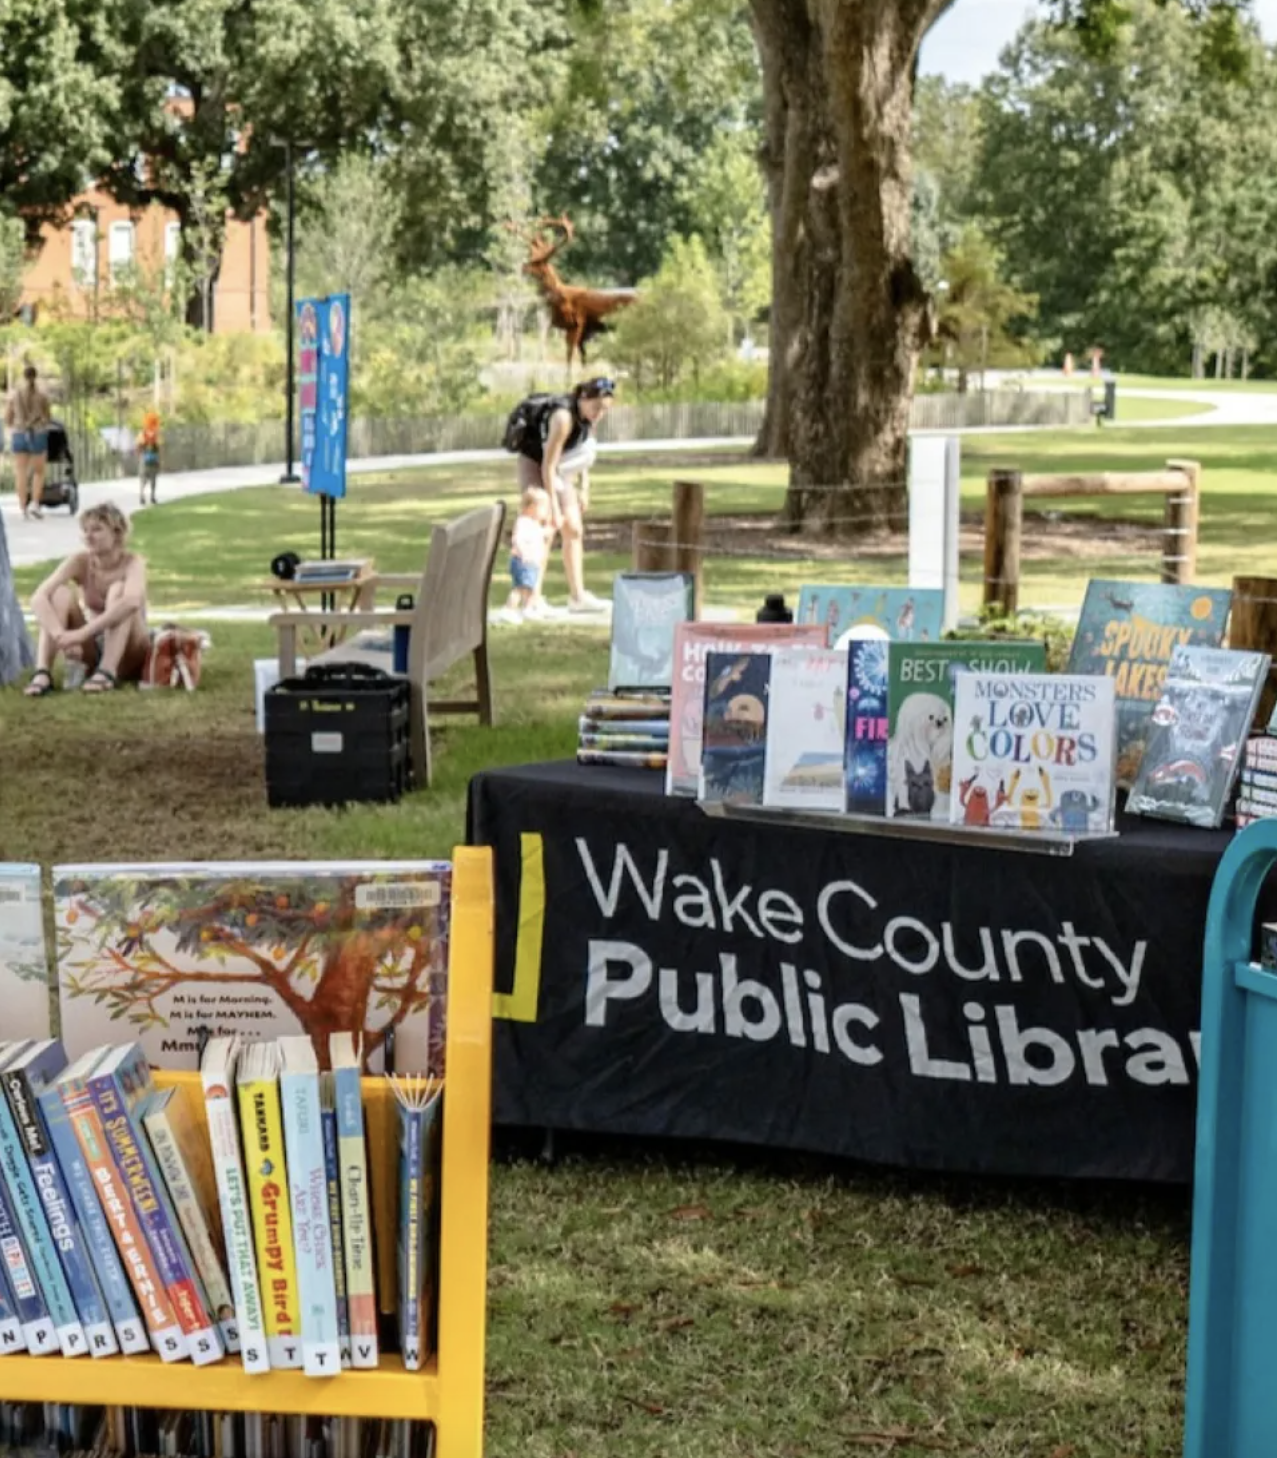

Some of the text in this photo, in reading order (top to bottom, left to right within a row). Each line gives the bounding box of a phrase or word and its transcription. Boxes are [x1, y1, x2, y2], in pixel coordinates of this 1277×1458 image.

[1100, 613, 1194, 659] SPOOKY
[900, 659, 1031, 682] BEST SHOW
[974, 680, 1096, 700] MONSTERS
[988, 700, 1080, 729] LOVE
[966, 730, 1097, 765] COLORS
[576, 837, 1147, 1006] Wake County
[173, 996, 184, 1004] M
[198, 995, 214, 1003] for
[217, 995, 269, 1006] Morning.
[586, 940, 882, 1065] Public
[170, 1010, 181, 1018] M
[195, 1009, 211, 1018] for
[98, 1088, 120, 1114] IT'S
[225, 1166, 242, 1205] LET'S
[33, 1161, 76, 1253] Feelings
[231, 1208, 245, 1237] PUT
[235, 1241, 252, 1277] THAT
[260, 1181, 288, 1327] Grumpy Bird
[2, 1330, 16, 1344] N
[36, 1330, 46, 1344] P
[124, 1328, 135, 1341] S
[227, 1327, 238, 1340] S
[69, 1334, 79, 1348] P
[94, 1335, 106, 1349] R
[165, 1337, 177, 1351] S
[198, 1339, 210, 1352] S
[247, 1349, 259, 1362] S
[285, 1348, 296, 1361] T
[315, 1353, 327, 1365] T
[357, 1347, 370, 1359] V
